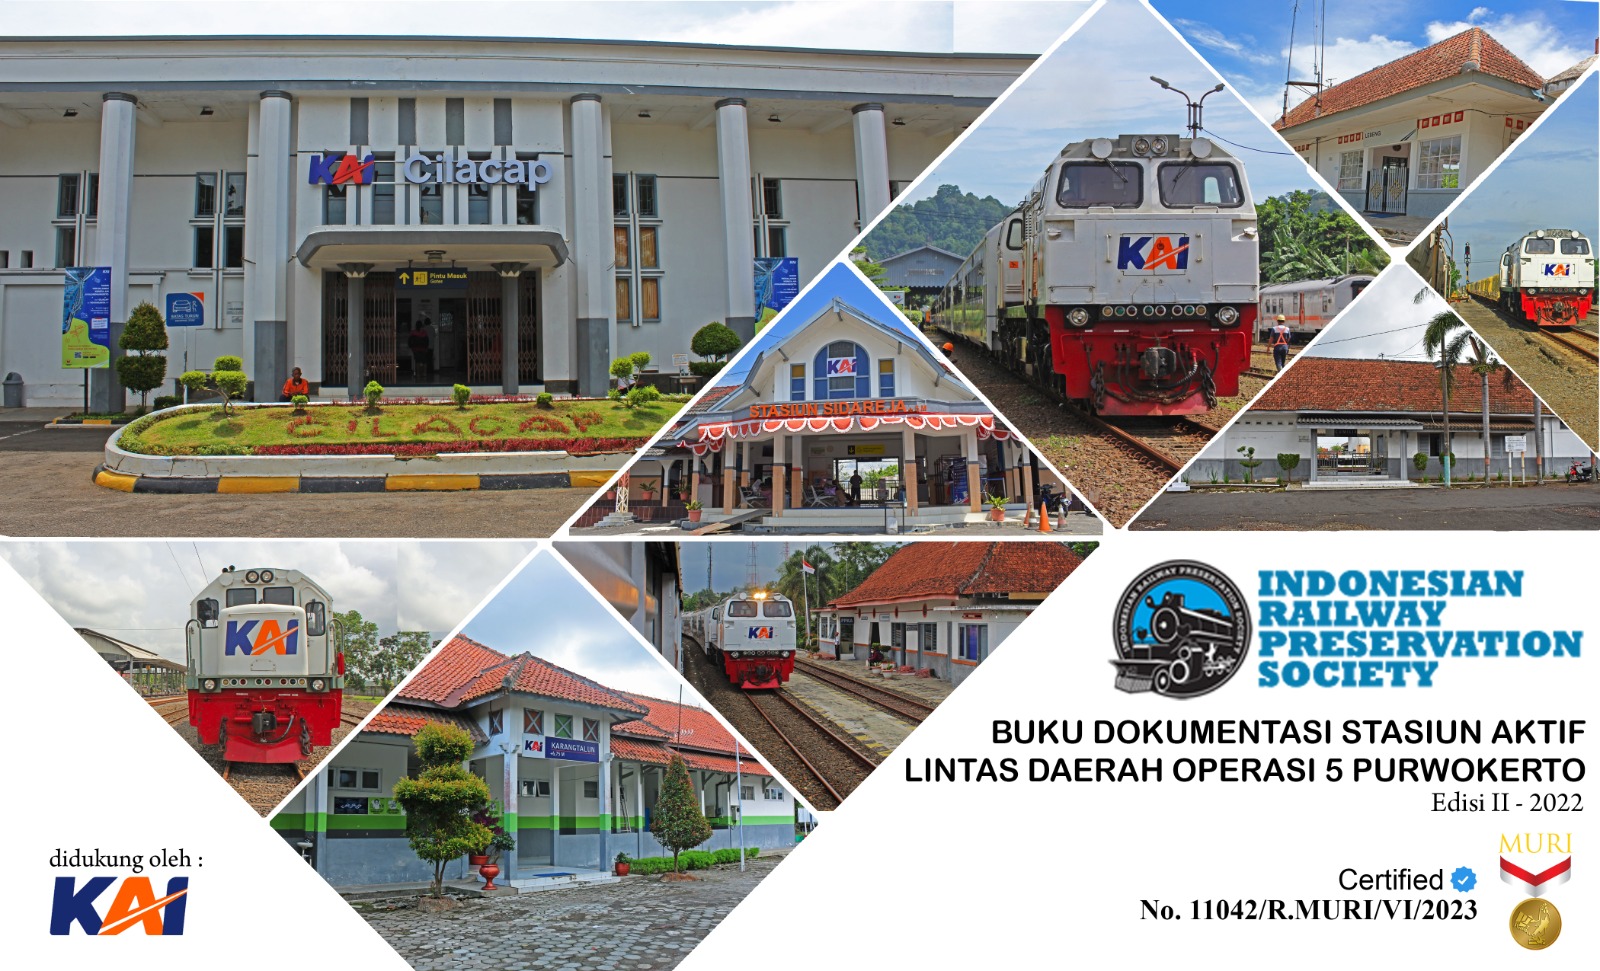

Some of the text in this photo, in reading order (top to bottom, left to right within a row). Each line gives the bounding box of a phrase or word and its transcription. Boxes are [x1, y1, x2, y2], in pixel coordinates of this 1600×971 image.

[309, 154, 553, 192] KAI Cilacap
[1117, 236, 1190, 270] KAI
[1544, 263, 1571, 276] KAI
[827, 359, 856, 375] KAI
[749, 402, 818, 419] STASIUN
[823, 399, 907, 416] SIDAREJA
[225, 619, 300, 656] KAI
[748, 626, 774, 639] KAI
[525, 740, 543, 752] KAI
[551, 742, 595, 753] KARANGTALUN
